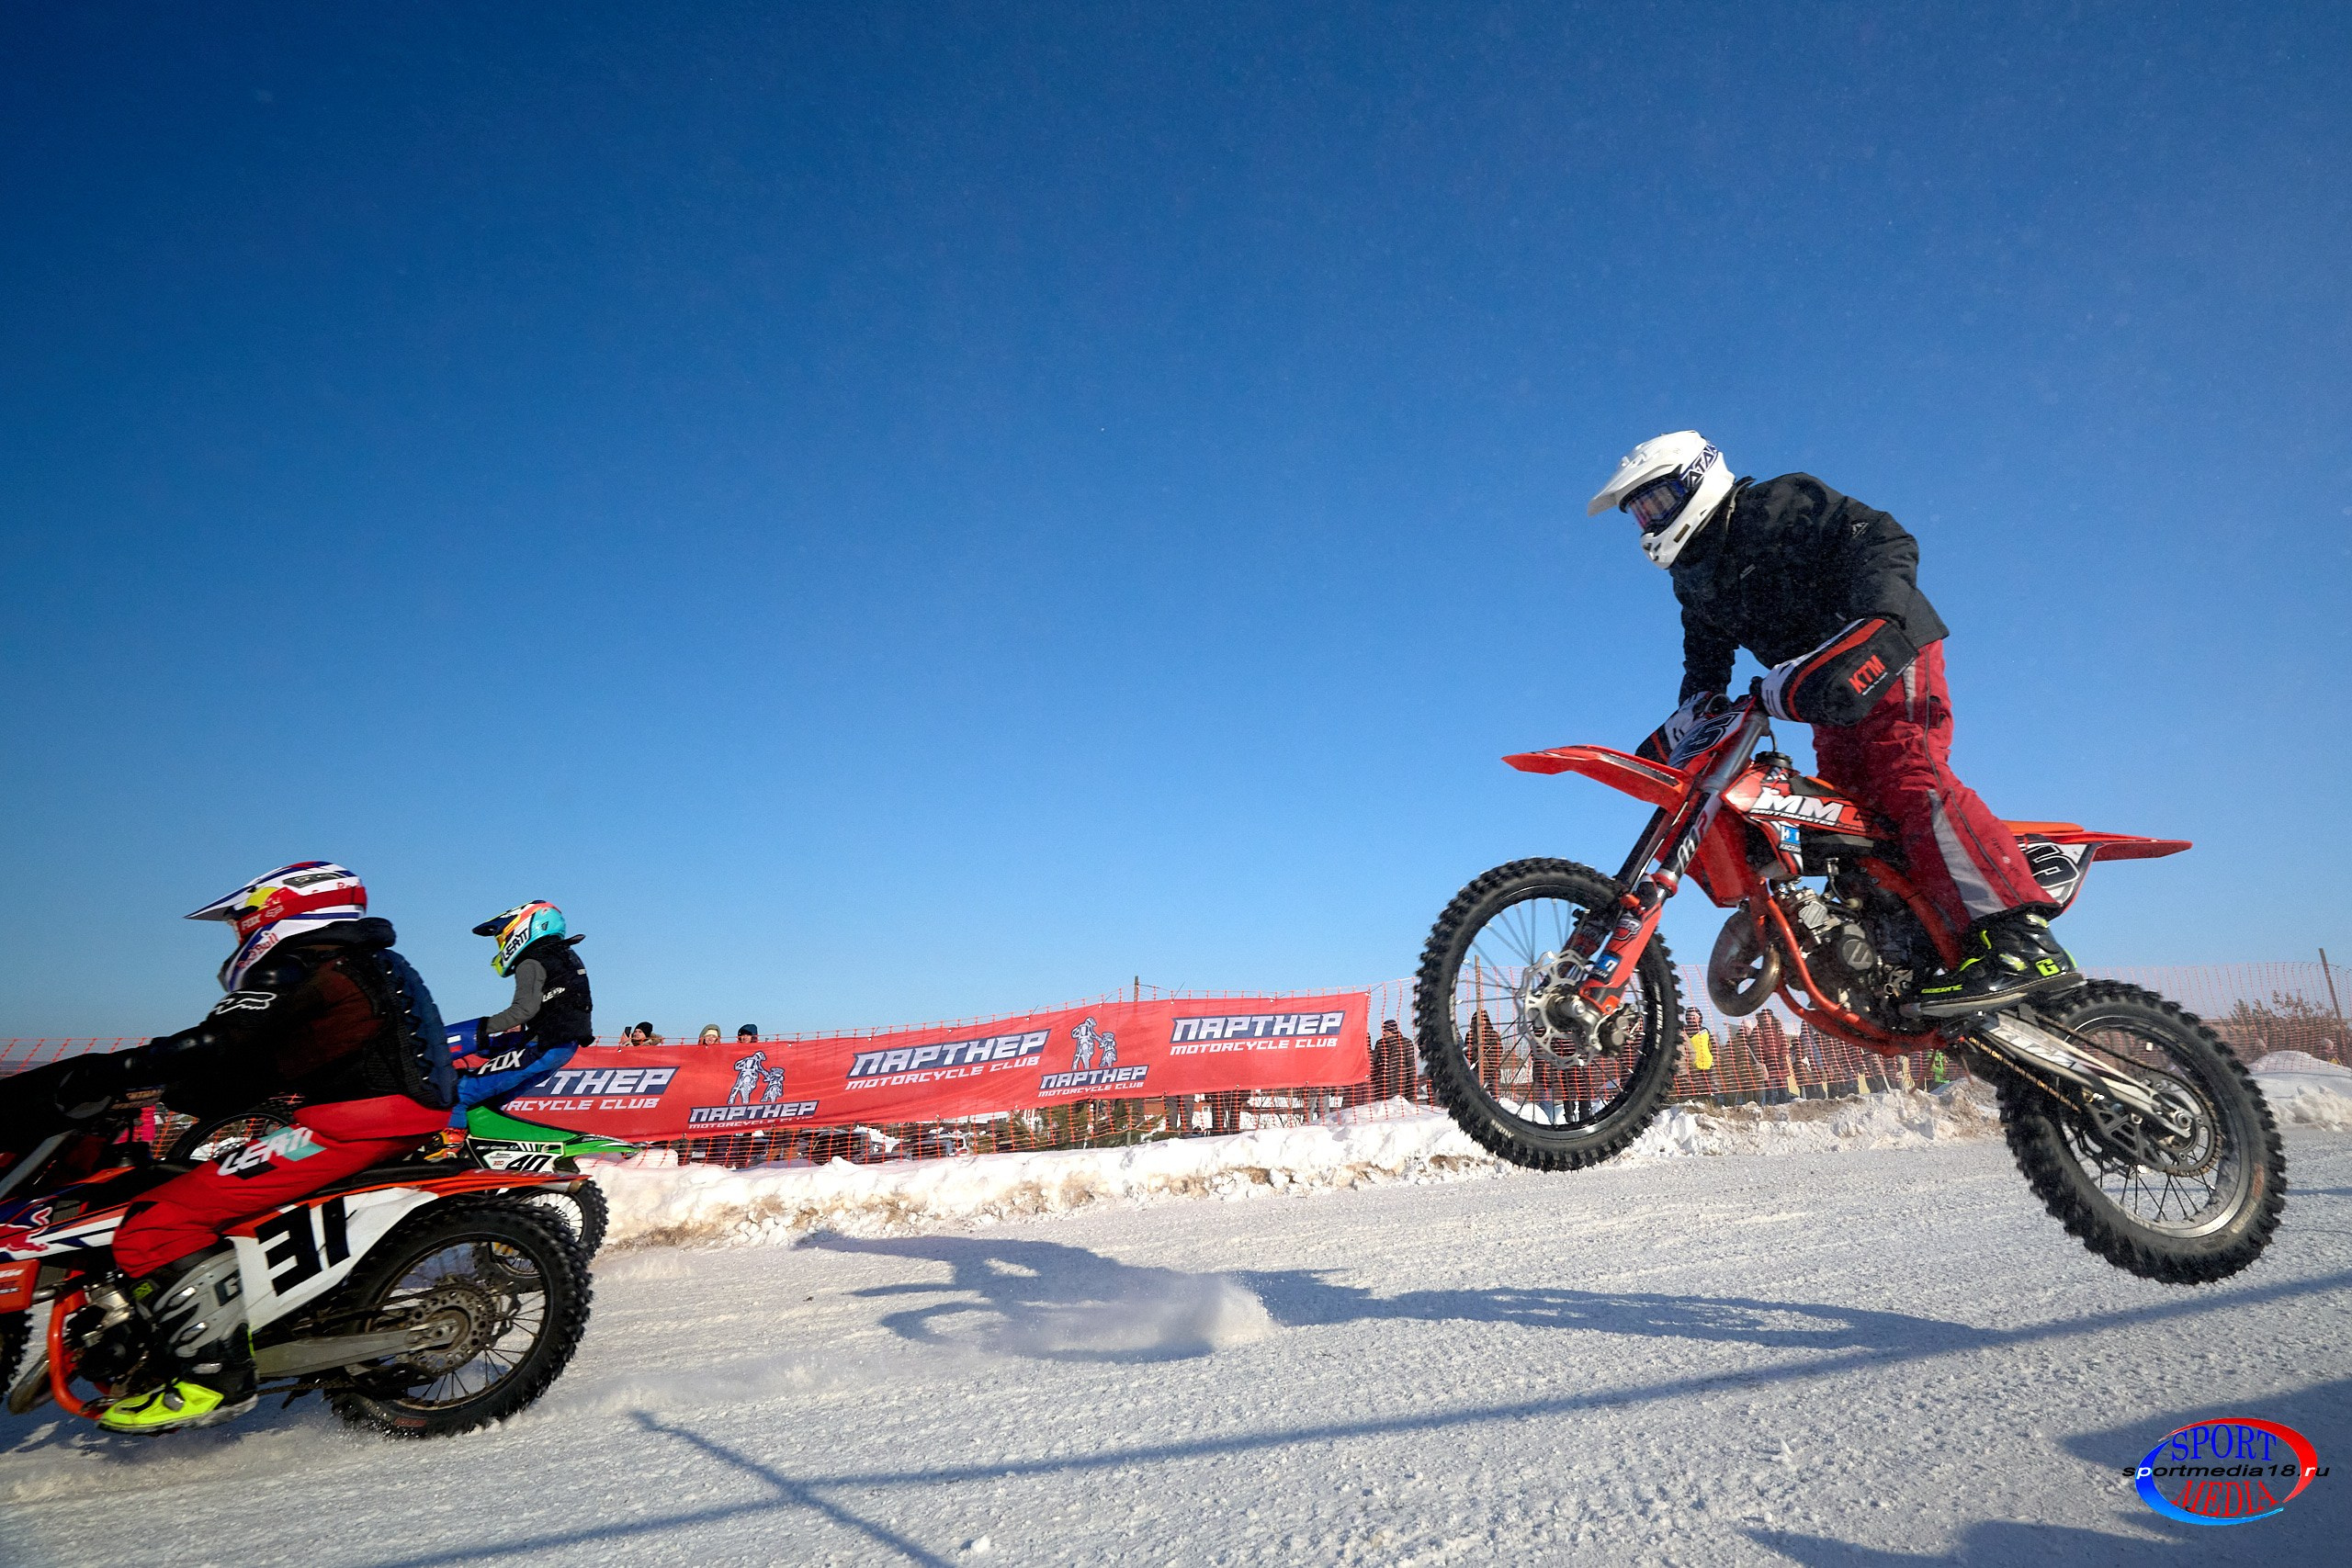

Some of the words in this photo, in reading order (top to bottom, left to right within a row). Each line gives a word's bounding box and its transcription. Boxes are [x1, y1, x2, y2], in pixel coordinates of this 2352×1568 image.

[1849, 654, 1886, 694] KTM
[1172, 1011, 1345, 1042] ПАРТНЕР
[849, 1030, 1049, 1077] ПАРТНЕР
[1170, 1039, 1289, 1056] MOTORCYCLE
[1295, 1037, 1338, 1049] CLUB
[477, 1048, 526, 1075] FOX
[844, 1066, 983, 1090] MOTORCYCLE
[989, 1055, 1041, 1073] CLUB
[1037, 1084, 1113, 1098] MOTORCYCLE
[1114, 1081, 1144, 1089] CLUB
[1039, 1066, 1148, 1089] ПАРТНЕР
[598, 1097, 661, 1111] CLUB
[689, 1100, 819, 1122] ПАРТНЕР
[217, 1126, 313, 1177] LEATT
[503, 1154, 553, 1172] 40
